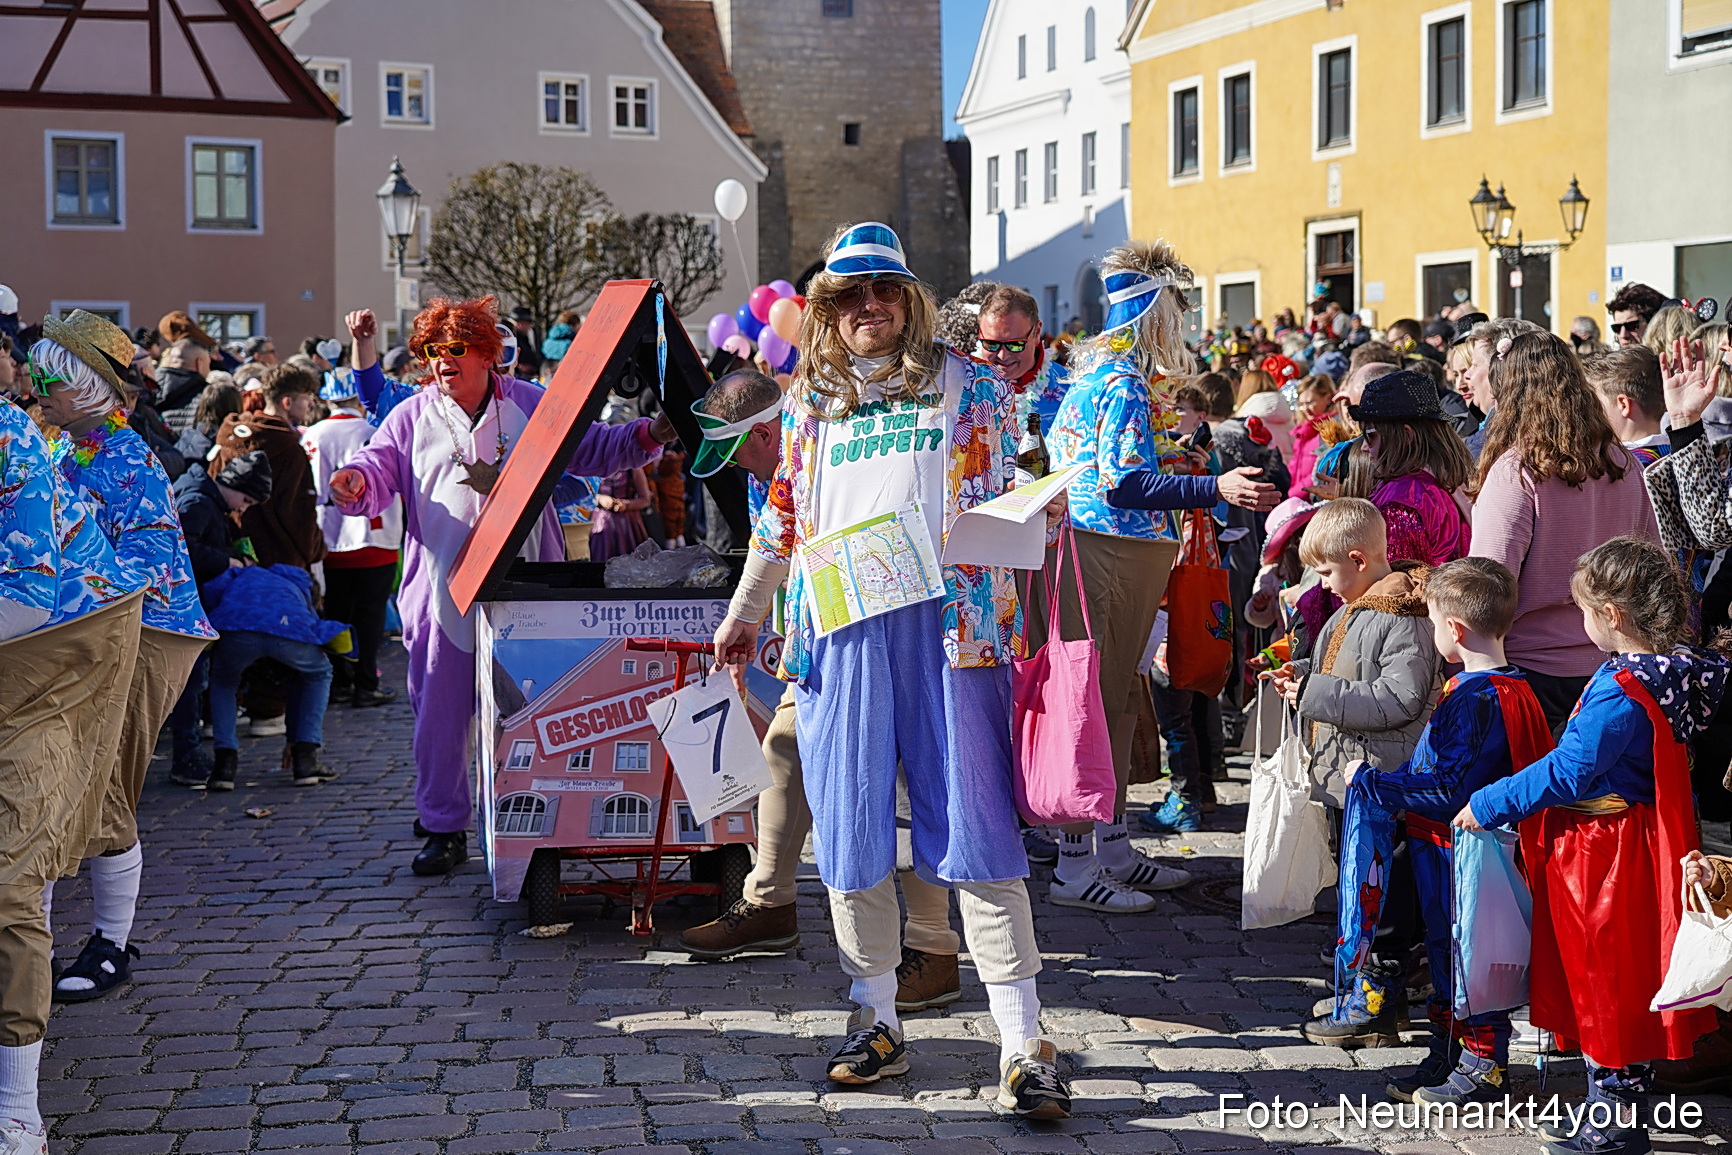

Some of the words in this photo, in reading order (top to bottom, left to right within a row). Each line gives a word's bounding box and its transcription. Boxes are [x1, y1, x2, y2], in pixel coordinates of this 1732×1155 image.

[852, 419, 875, 437] TO
[882, 413, 919, 431] THE
[830, 428, 943, 467] BUFFET?
[511, 612, 536, 620] Blaue
[518, 620, 547, 628] Traube
[580, 602, 627, 628] Zur
[634, 601, 706, 621] blauen
[692, 698, 730, 775] 7
[1102, 832, 1127, 843] adidas
[1060, 850, 1089, 858] adidas
[869, 1033, 894, 1060] N
